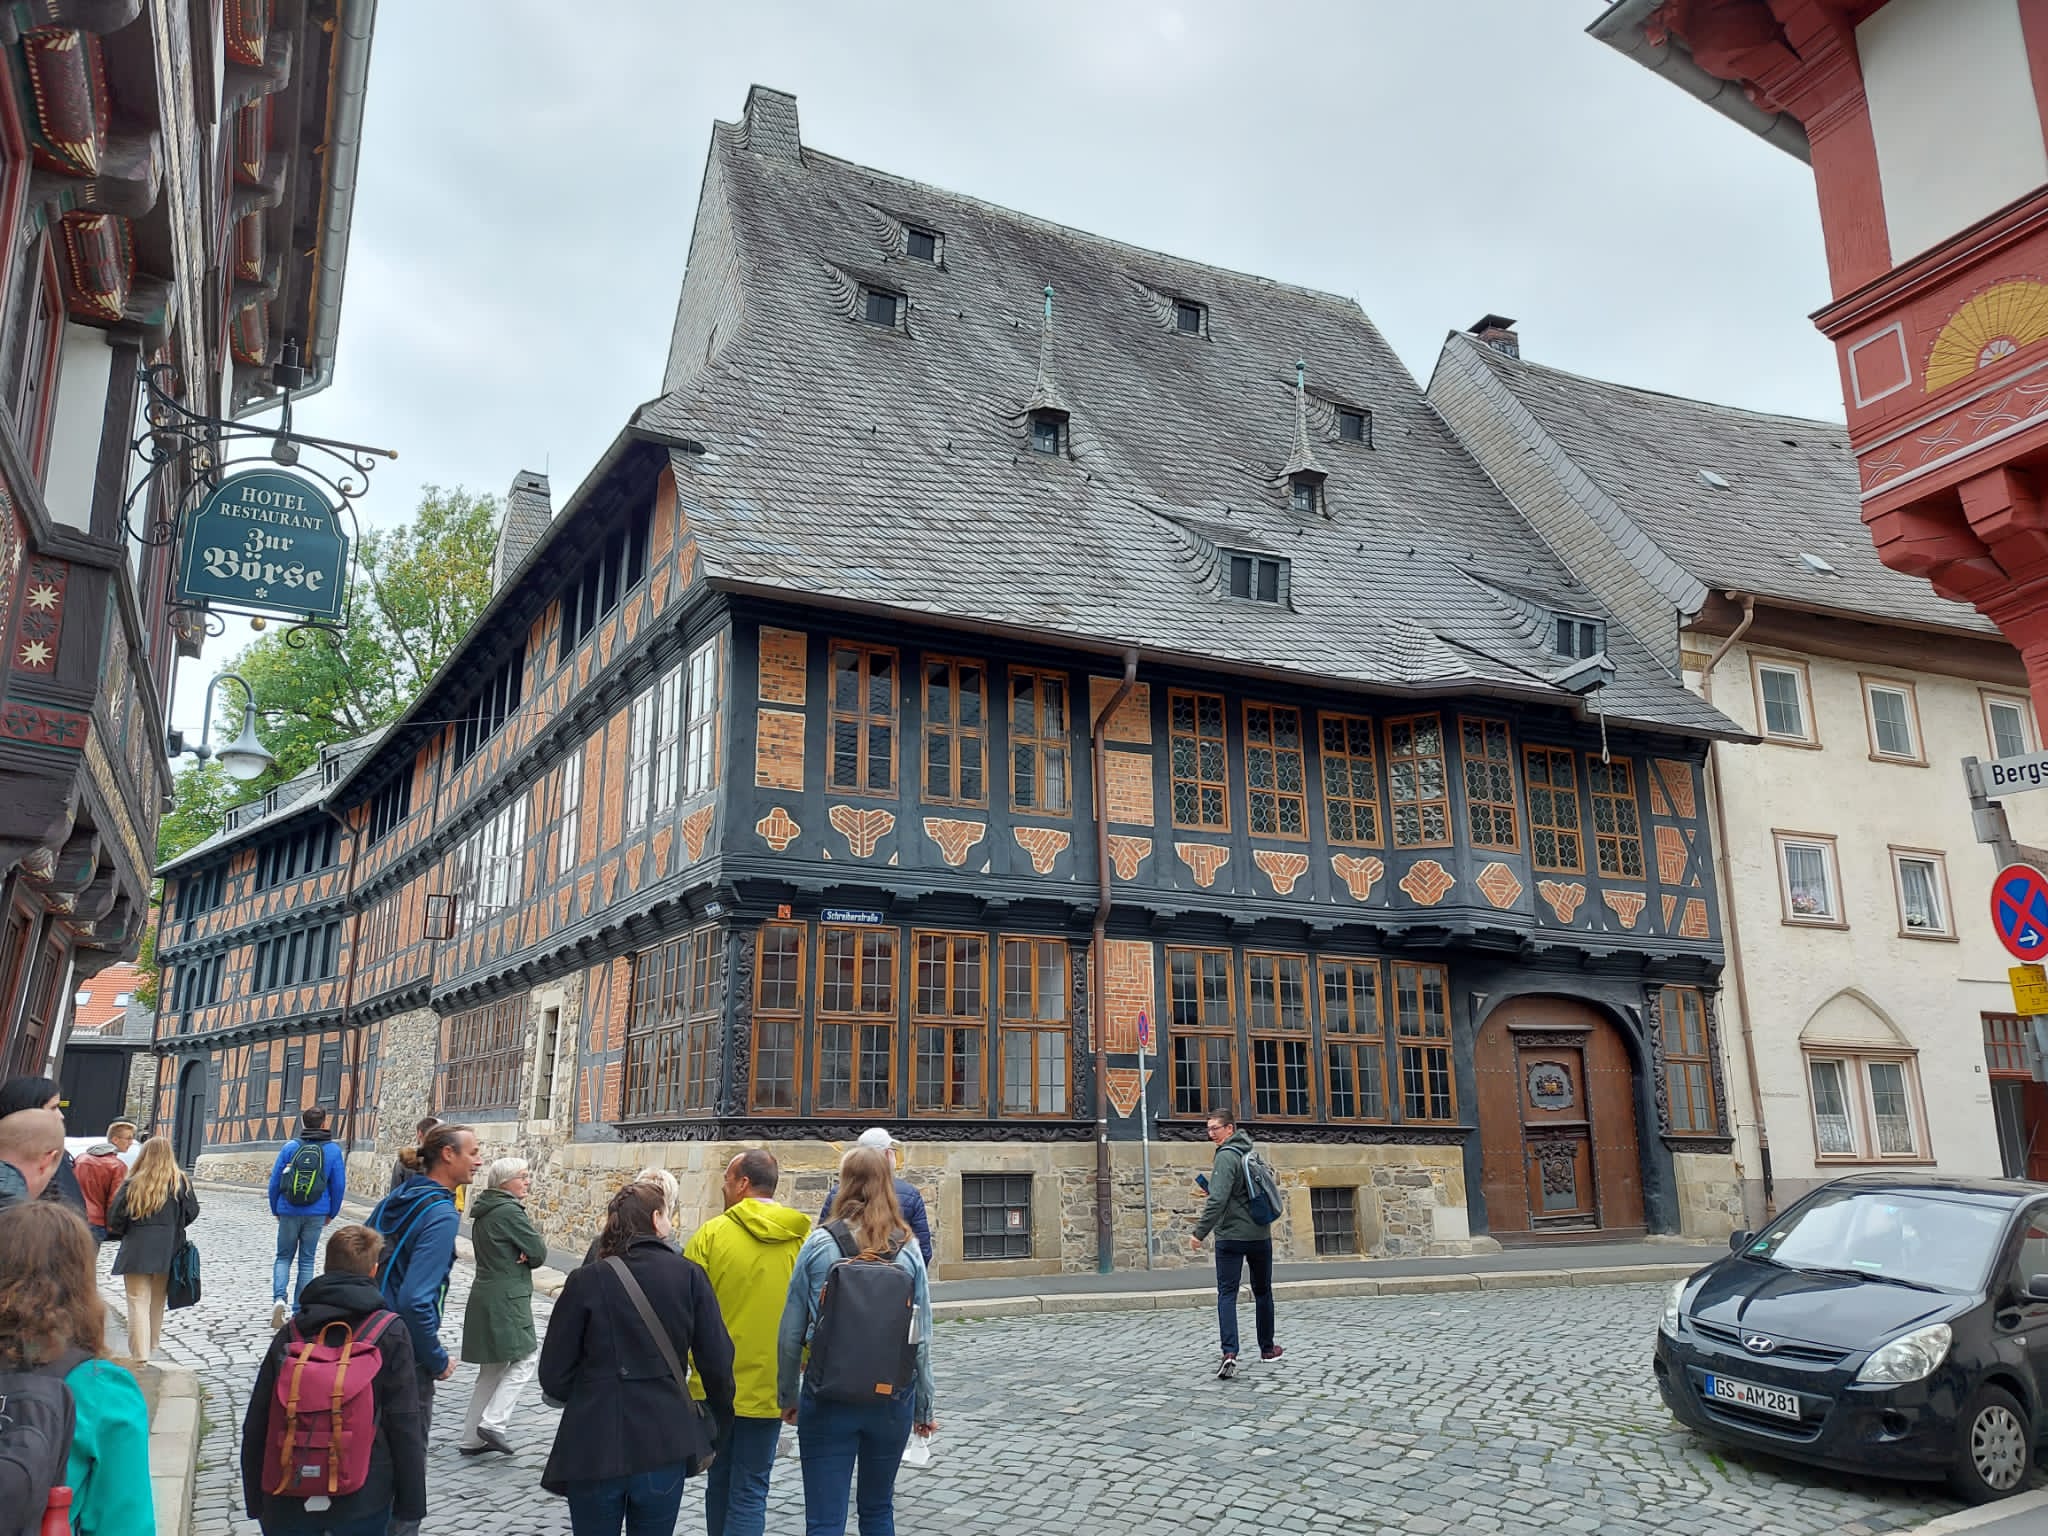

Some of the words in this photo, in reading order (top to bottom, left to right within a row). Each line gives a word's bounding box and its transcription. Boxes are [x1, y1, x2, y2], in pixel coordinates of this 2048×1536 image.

[240, 486, 307, 512] HOTEL
[220, 503, 323, 531] RESTAURANT
[243, 527, 294, 553] Zur
[203, 546, 324, 591] Börse
[1715, 1379, 1735, 1398] GS
